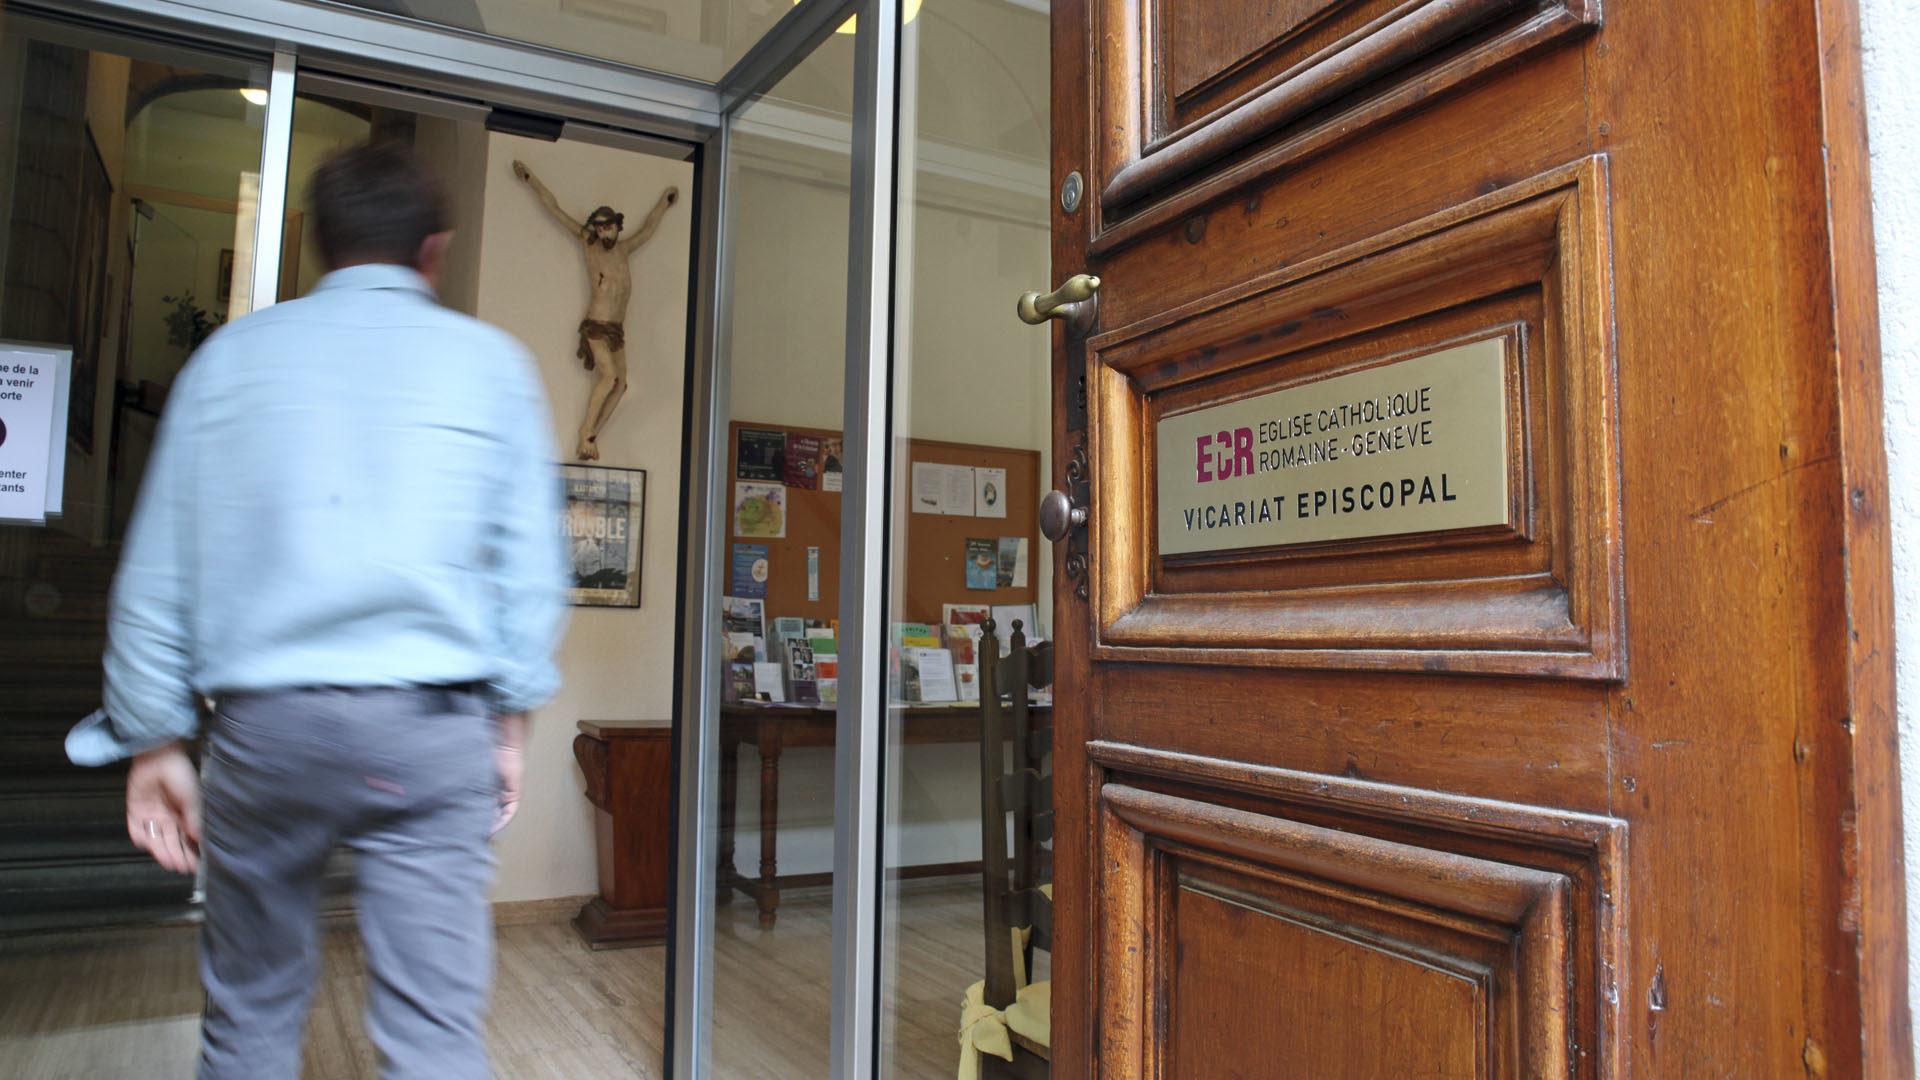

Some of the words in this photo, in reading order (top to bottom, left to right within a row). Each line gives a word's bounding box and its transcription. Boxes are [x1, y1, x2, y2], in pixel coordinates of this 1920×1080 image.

[6, 378, 34, 388] venir
[12, 364, 26, 374] de
[29, 365, 39, 375] la
[0, 391, 22, 401] orte
[1259, 413, 1312, 444] EGLISE
[1317, 387, 1432, 432] CATHOLIQUE
[1196, 427, 1255, 483] ECR
[1259, 438, 1338, 474] ROMAINE
[1351, 420, 1432, 457] GENEVE
[0, 484, 25, 493] ants
[1184, 496, 1285, 531] VICARIAT
[1298, 473, 1456, 518] EPISCOPAL
